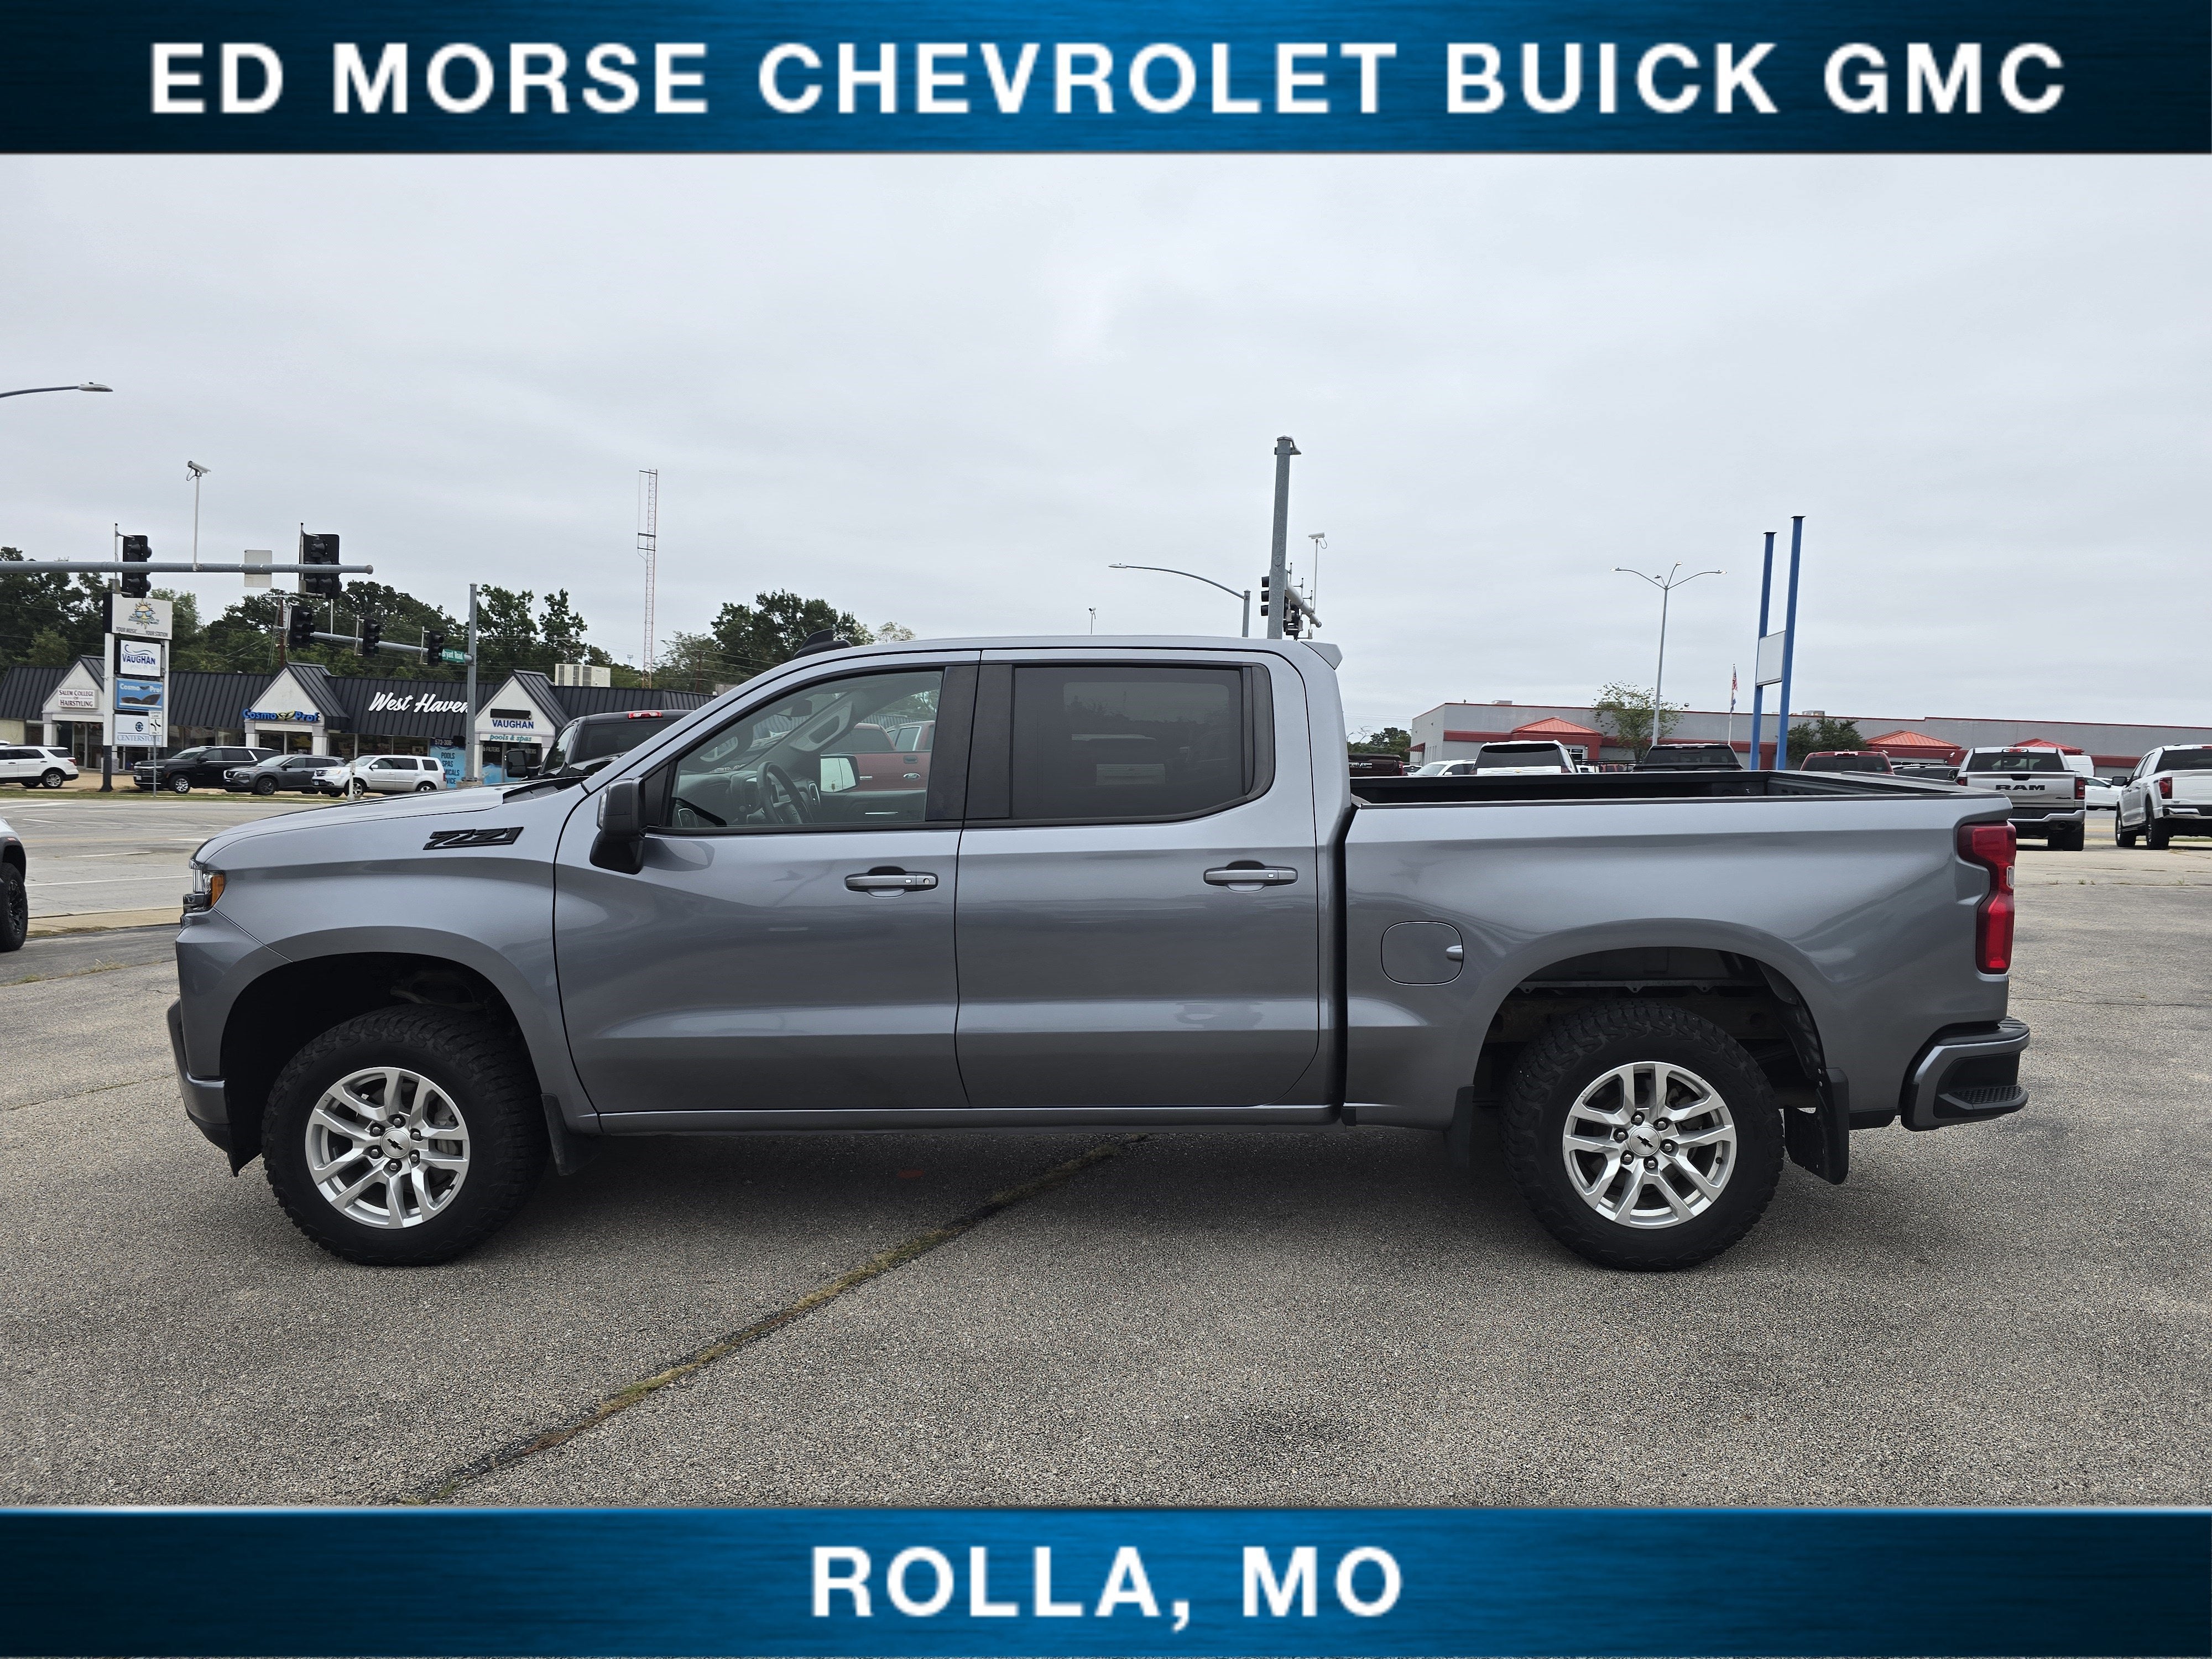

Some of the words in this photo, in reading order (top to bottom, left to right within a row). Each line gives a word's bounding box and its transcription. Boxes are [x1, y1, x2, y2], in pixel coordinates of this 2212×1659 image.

[122, 654, 155, 665] VAUGHAN
[368, 692, 414, 711] West
[242, 708, 277, 719] Cosmo
[295, 711, 320, 722] Prof
[492, 719, 534, 729] VAUGHAN
